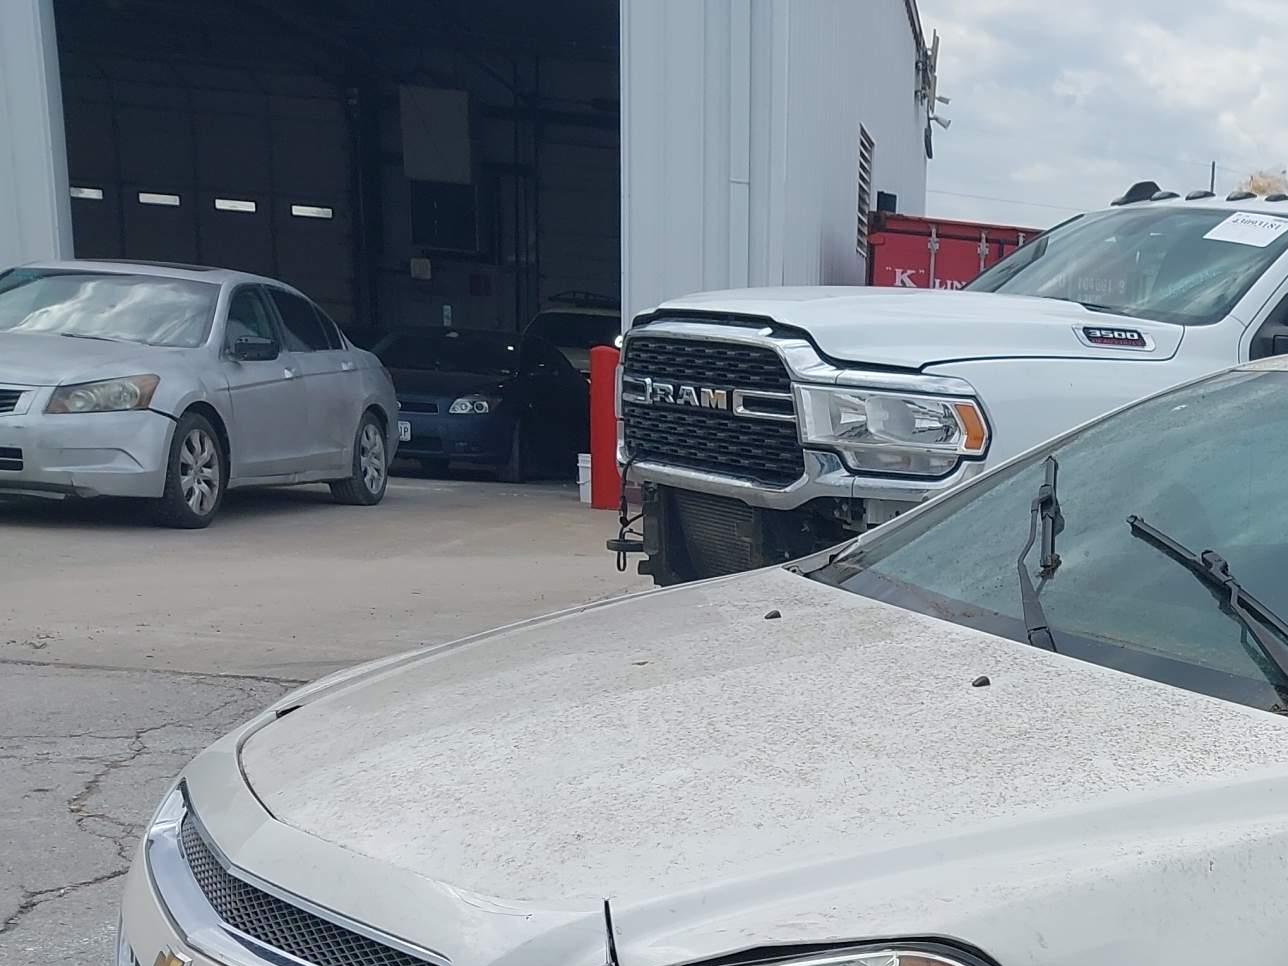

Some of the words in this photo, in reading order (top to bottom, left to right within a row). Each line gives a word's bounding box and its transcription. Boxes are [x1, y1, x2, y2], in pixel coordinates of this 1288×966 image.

[934, 278, 968, 291] LIN
[1088, 329, 1139, 340] 3500
[652, 382, 728, 410] RAM
